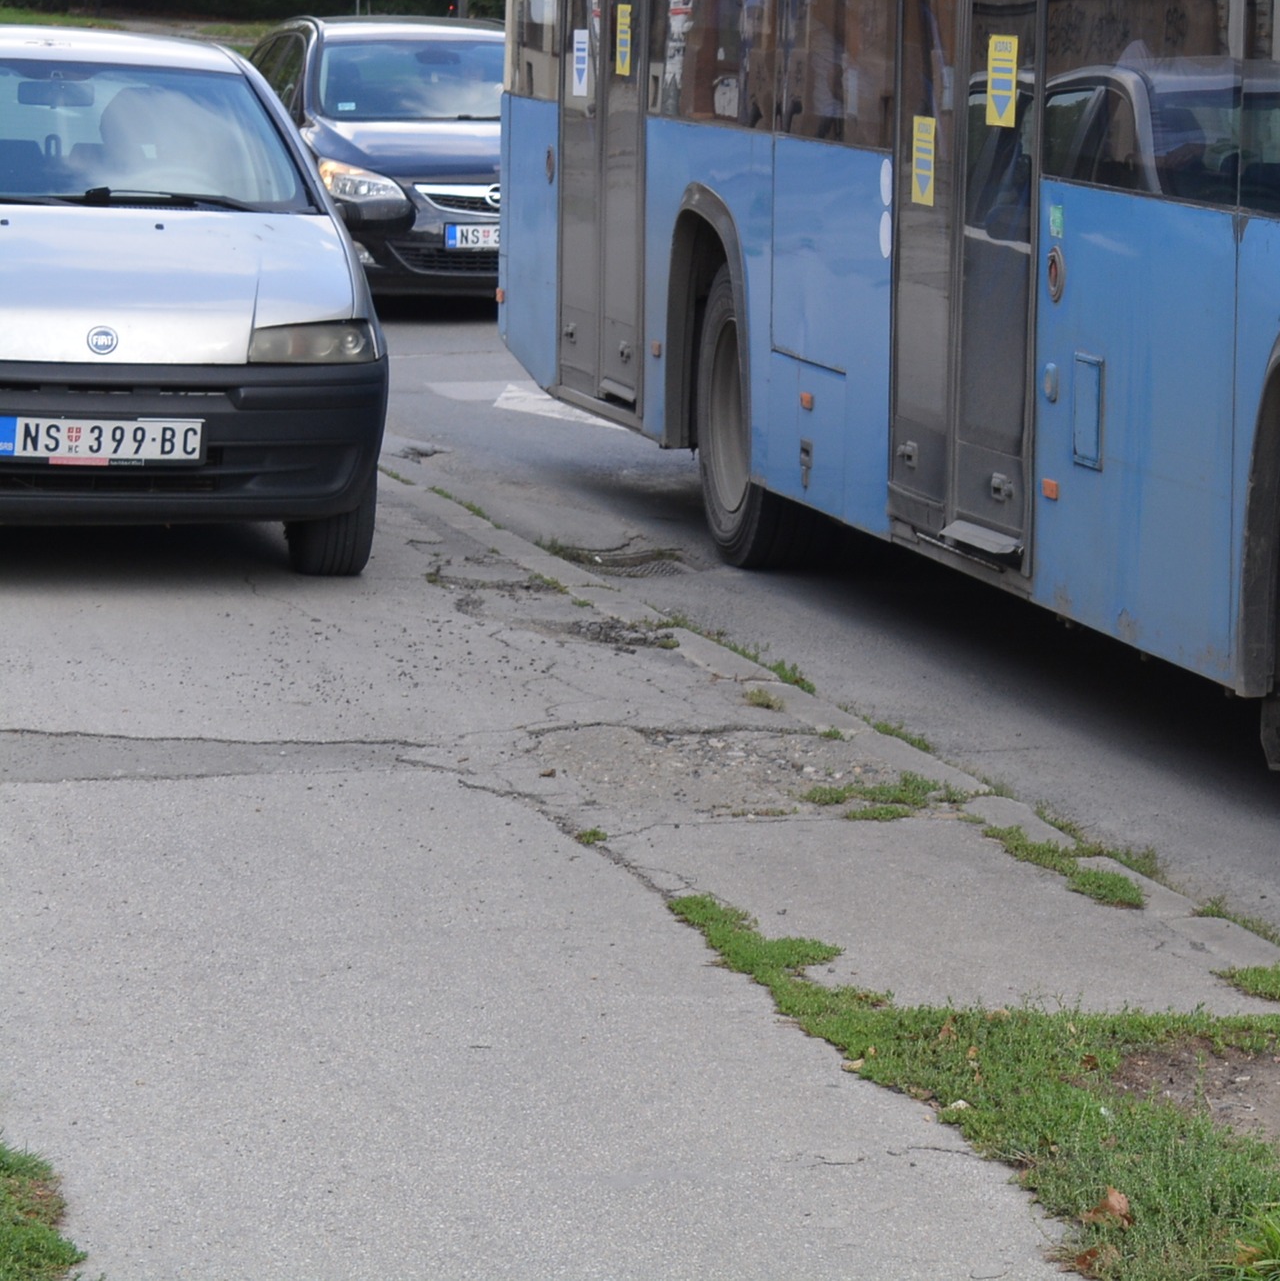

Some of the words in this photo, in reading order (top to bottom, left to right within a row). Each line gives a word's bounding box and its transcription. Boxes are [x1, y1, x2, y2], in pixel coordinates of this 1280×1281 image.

[460, 228, 480, 245] NS
[92, 335, 113, 347] FIAT
[22, 422, 61, 453] NS
